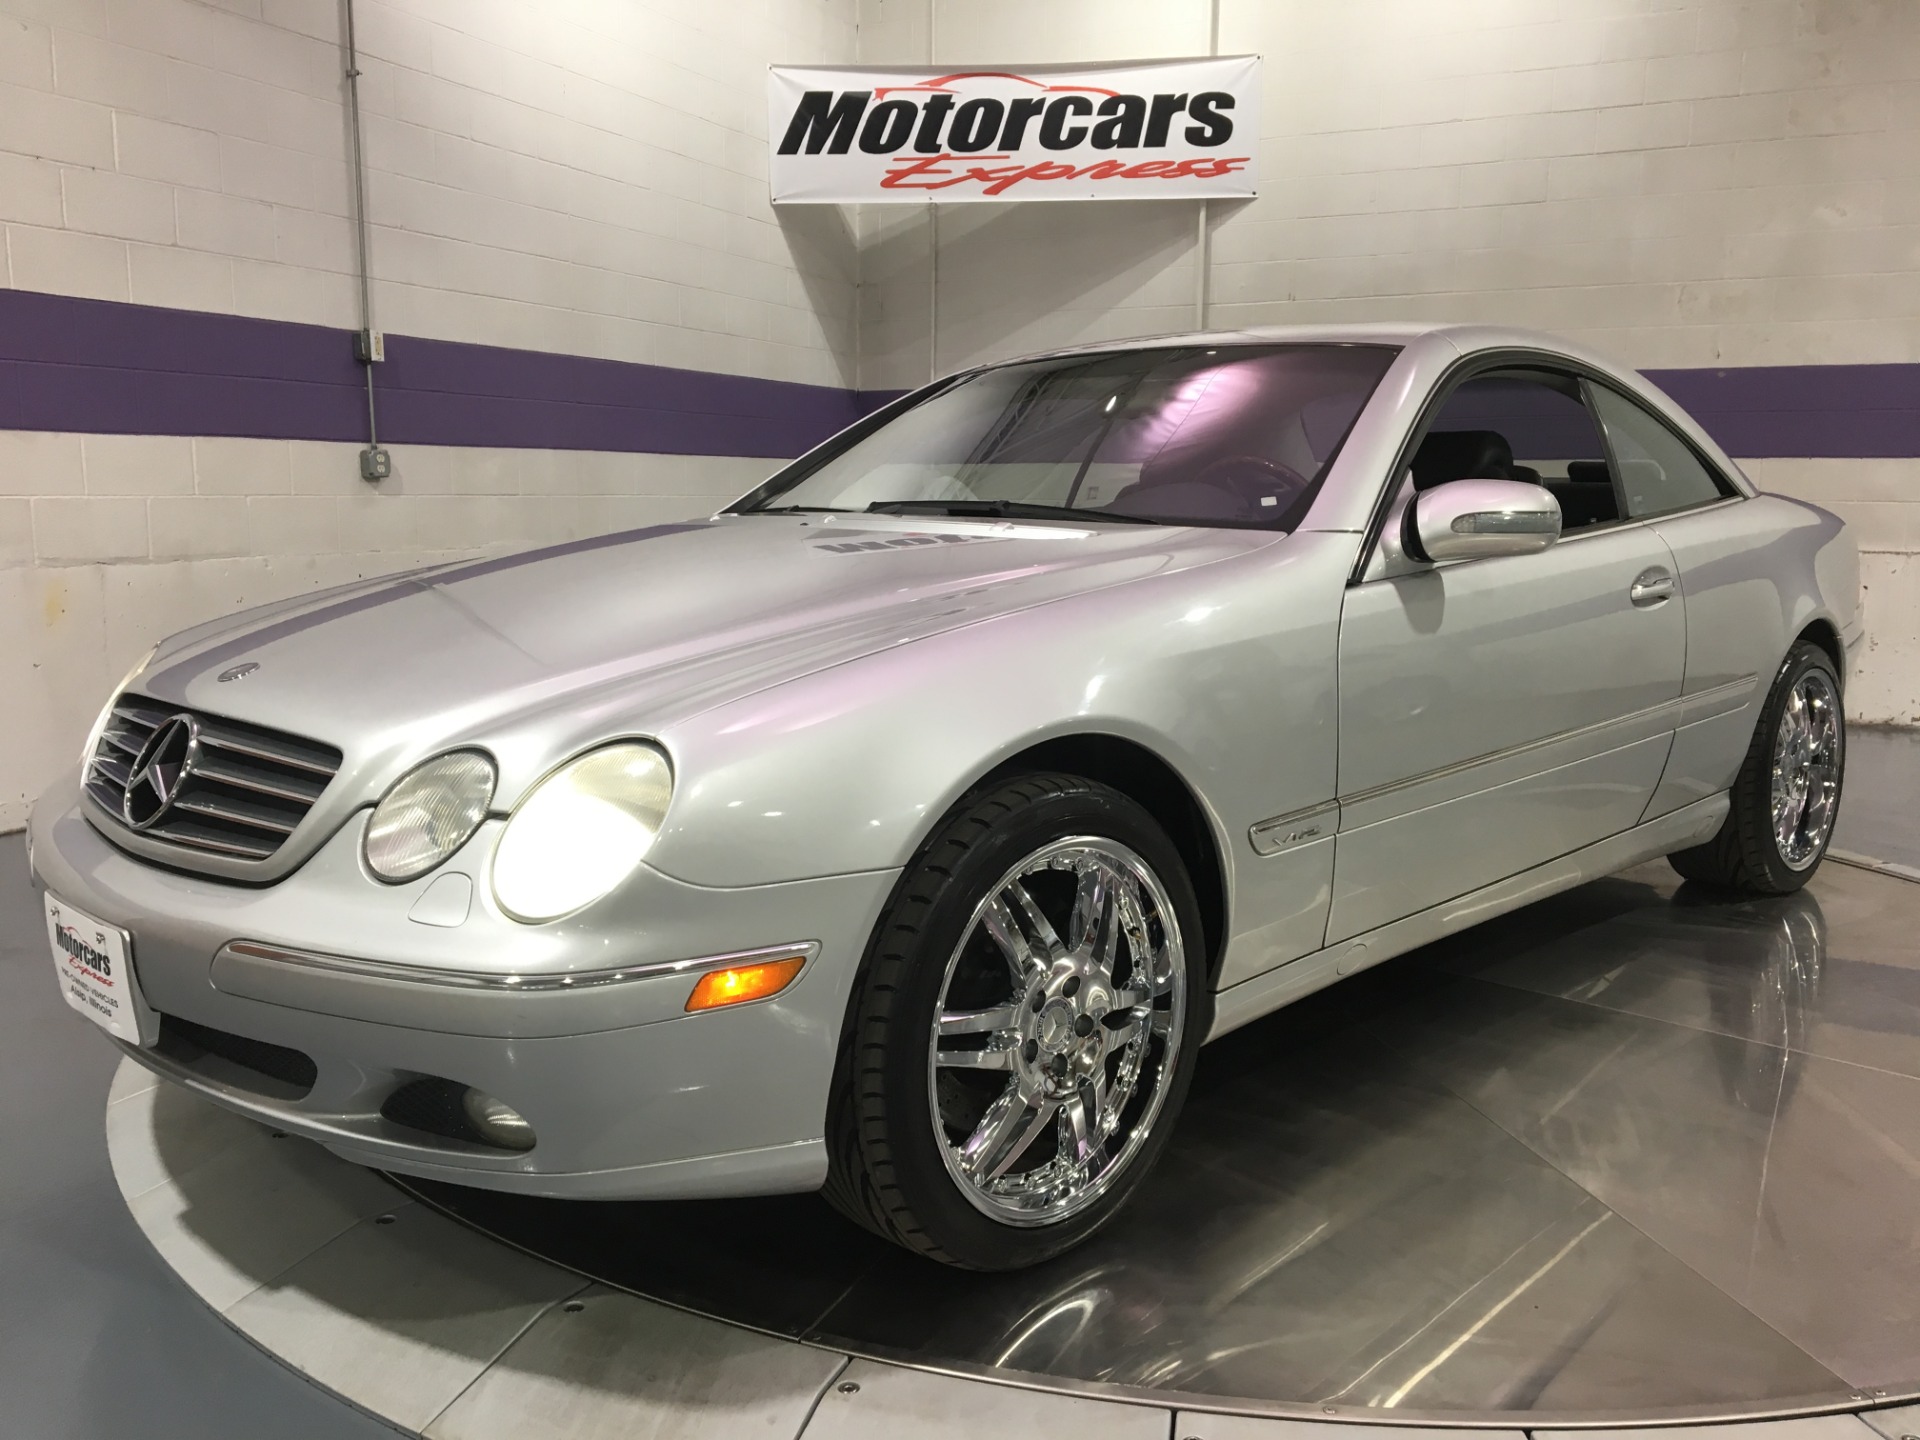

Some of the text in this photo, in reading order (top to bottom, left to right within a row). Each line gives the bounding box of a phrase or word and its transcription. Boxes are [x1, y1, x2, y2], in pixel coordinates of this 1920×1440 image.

[777, 90, 1235, 155] Motorcars
[880, 153, 1251, 195] Express
[56, 923, 111, 976] Motorcars
[68, 956, 115, 987] Express
[89, 996, 112, 1017] Illinois
